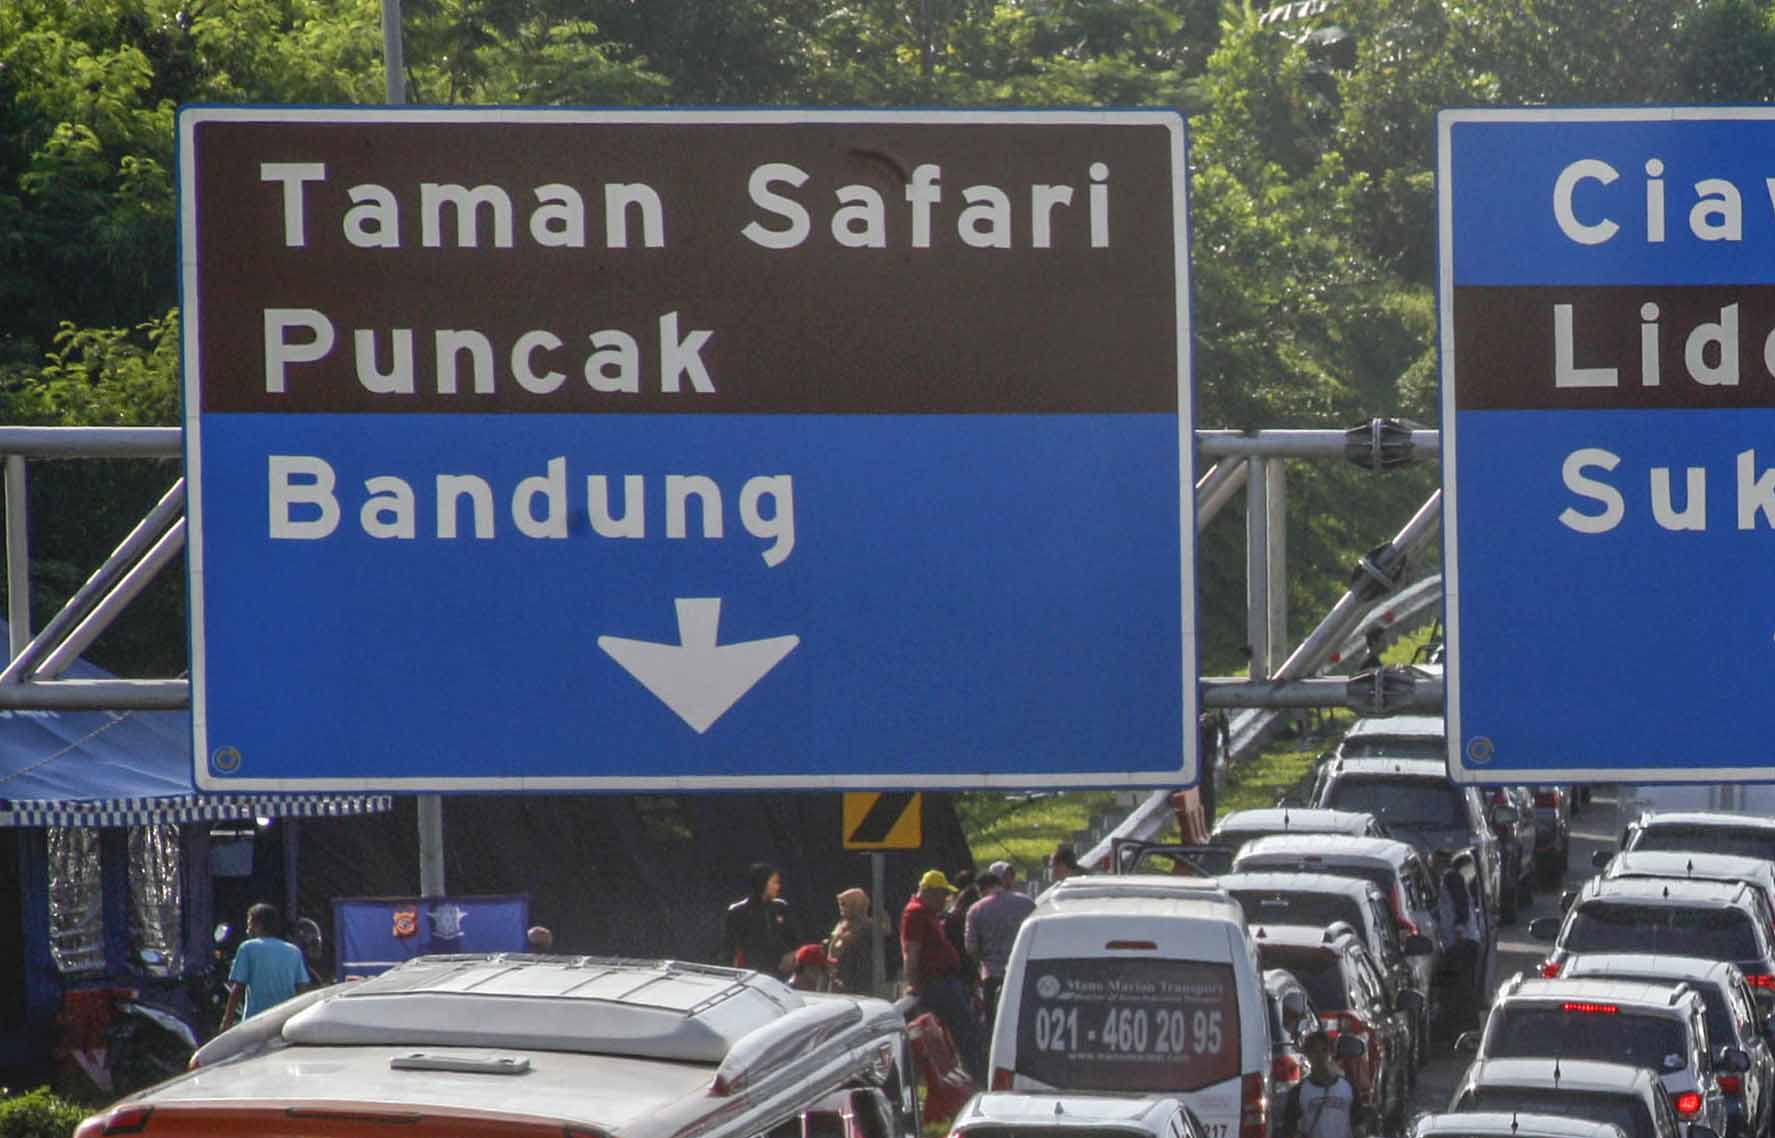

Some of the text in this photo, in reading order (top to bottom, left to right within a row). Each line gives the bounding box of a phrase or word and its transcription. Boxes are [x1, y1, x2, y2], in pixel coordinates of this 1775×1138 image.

[261, 162, 1110, 249] Taman Safari
[264, 308, 716, 394] Puncak
[268, 455, 796, 568] Bandung
[1035, 1007, 1079, 1051] 021
[1102, 1007, 1148, 1053] 460
[1154, 1008, 1185, 1053] 20
[1192, 1009, 1223, 1055] 95
